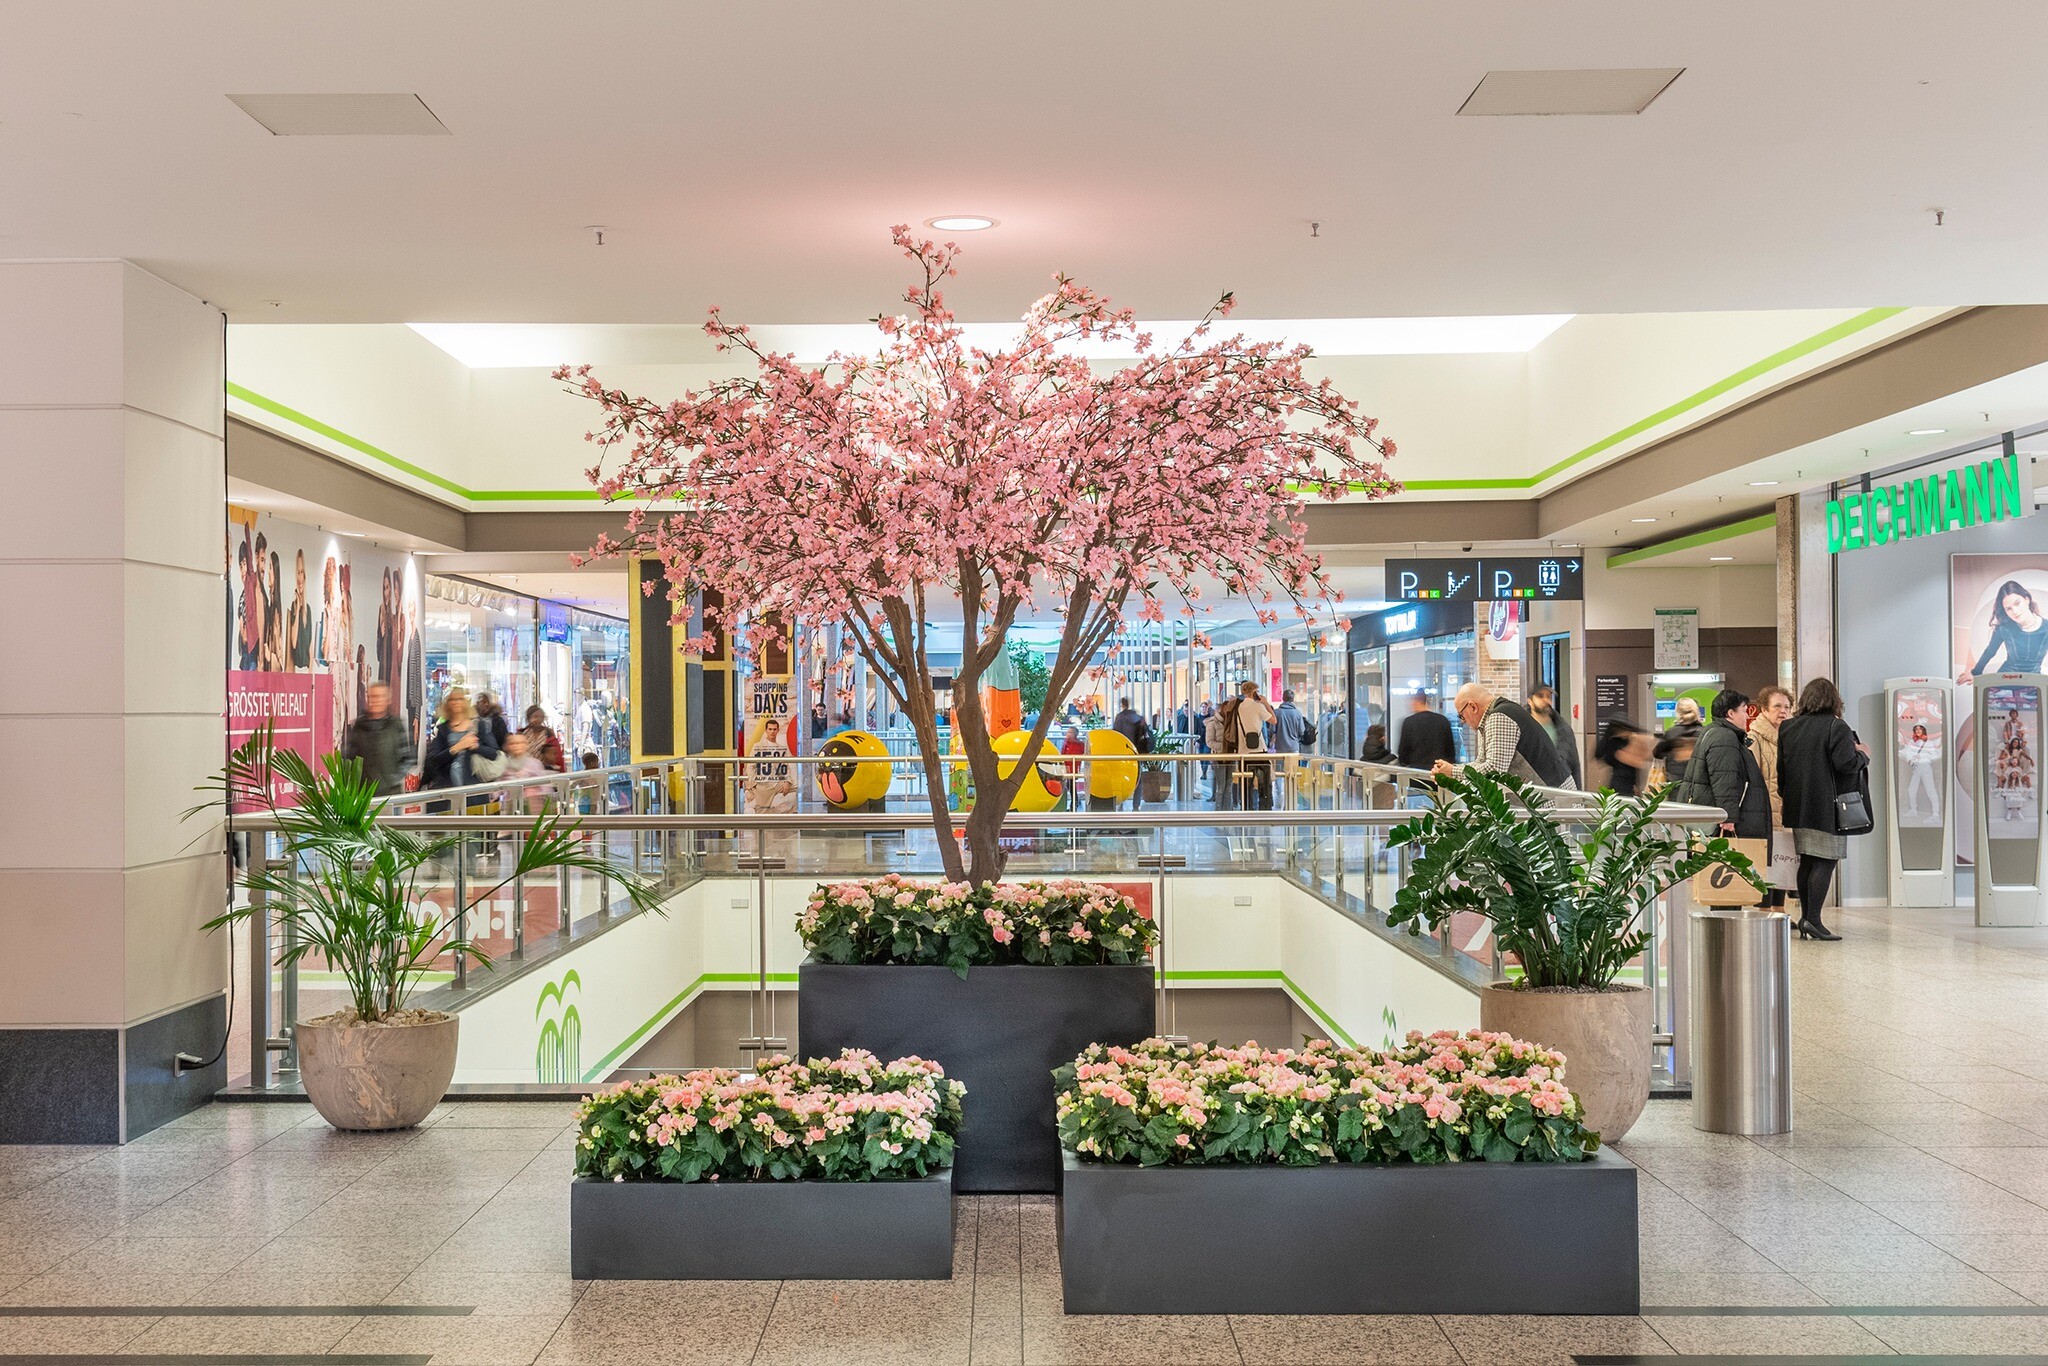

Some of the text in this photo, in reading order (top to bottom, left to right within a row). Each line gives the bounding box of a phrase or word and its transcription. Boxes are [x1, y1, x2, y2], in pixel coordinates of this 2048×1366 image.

[1826, 454, 2022, 554] DEICHMANN
[1401, 572, 1418, 598] P
[1495, 571, 1512, 597] P
[754, 683, 788, 693] SHOPPING
[226, 686, 308, 717] GRÖSSTE VIELFALT
[754, 694, 788, 714] DAYS
[754, 751, 788, 776] 15%
